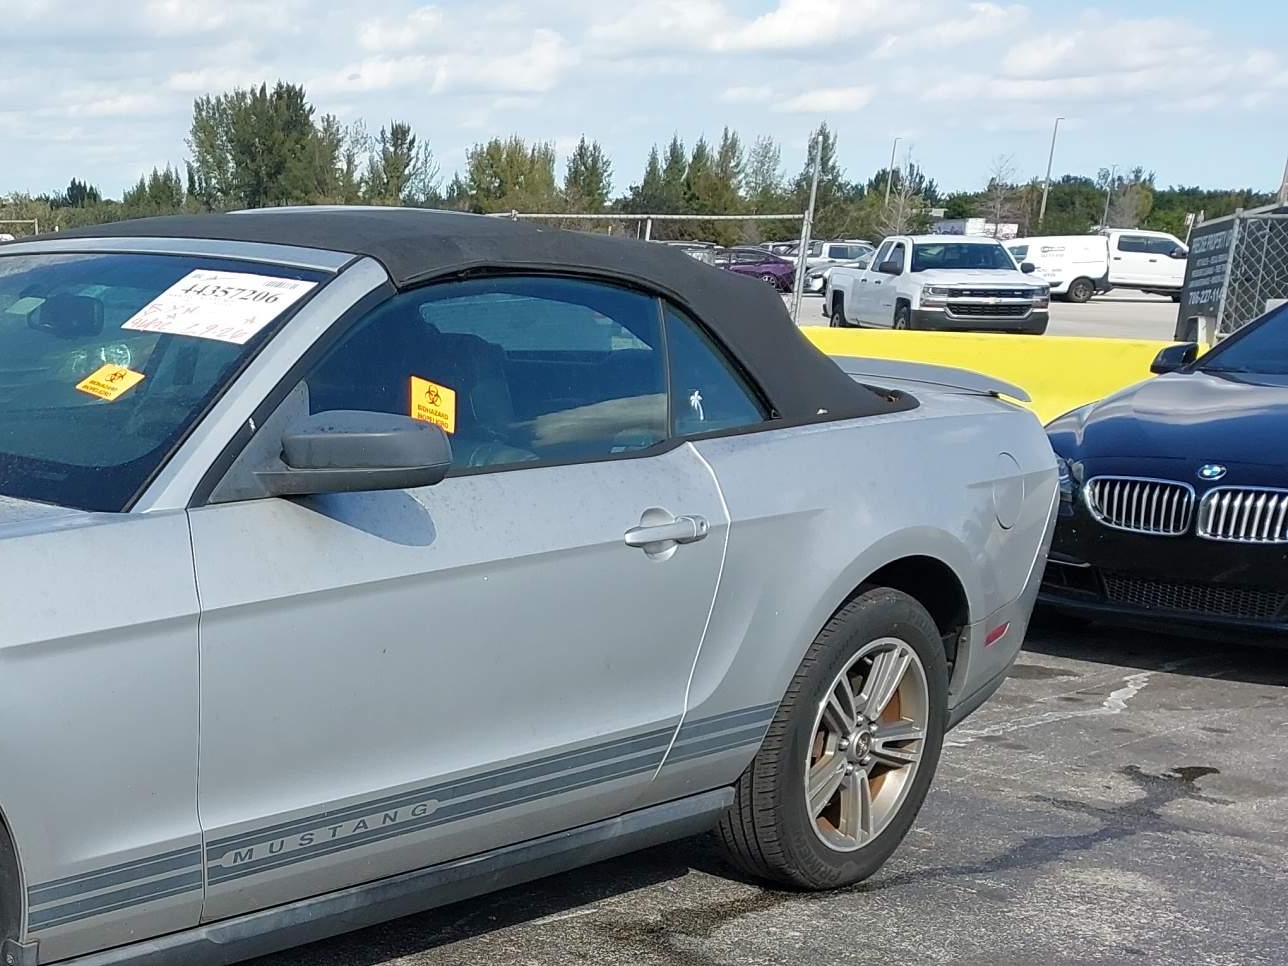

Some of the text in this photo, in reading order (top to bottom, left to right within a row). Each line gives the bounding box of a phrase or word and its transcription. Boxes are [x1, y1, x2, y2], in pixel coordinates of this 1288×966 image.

[181, 283, 279, 304] 44357206
[417, 404, 449, 420] BIOHAZARD
[232, 804, 428, 864] MUSTANG
